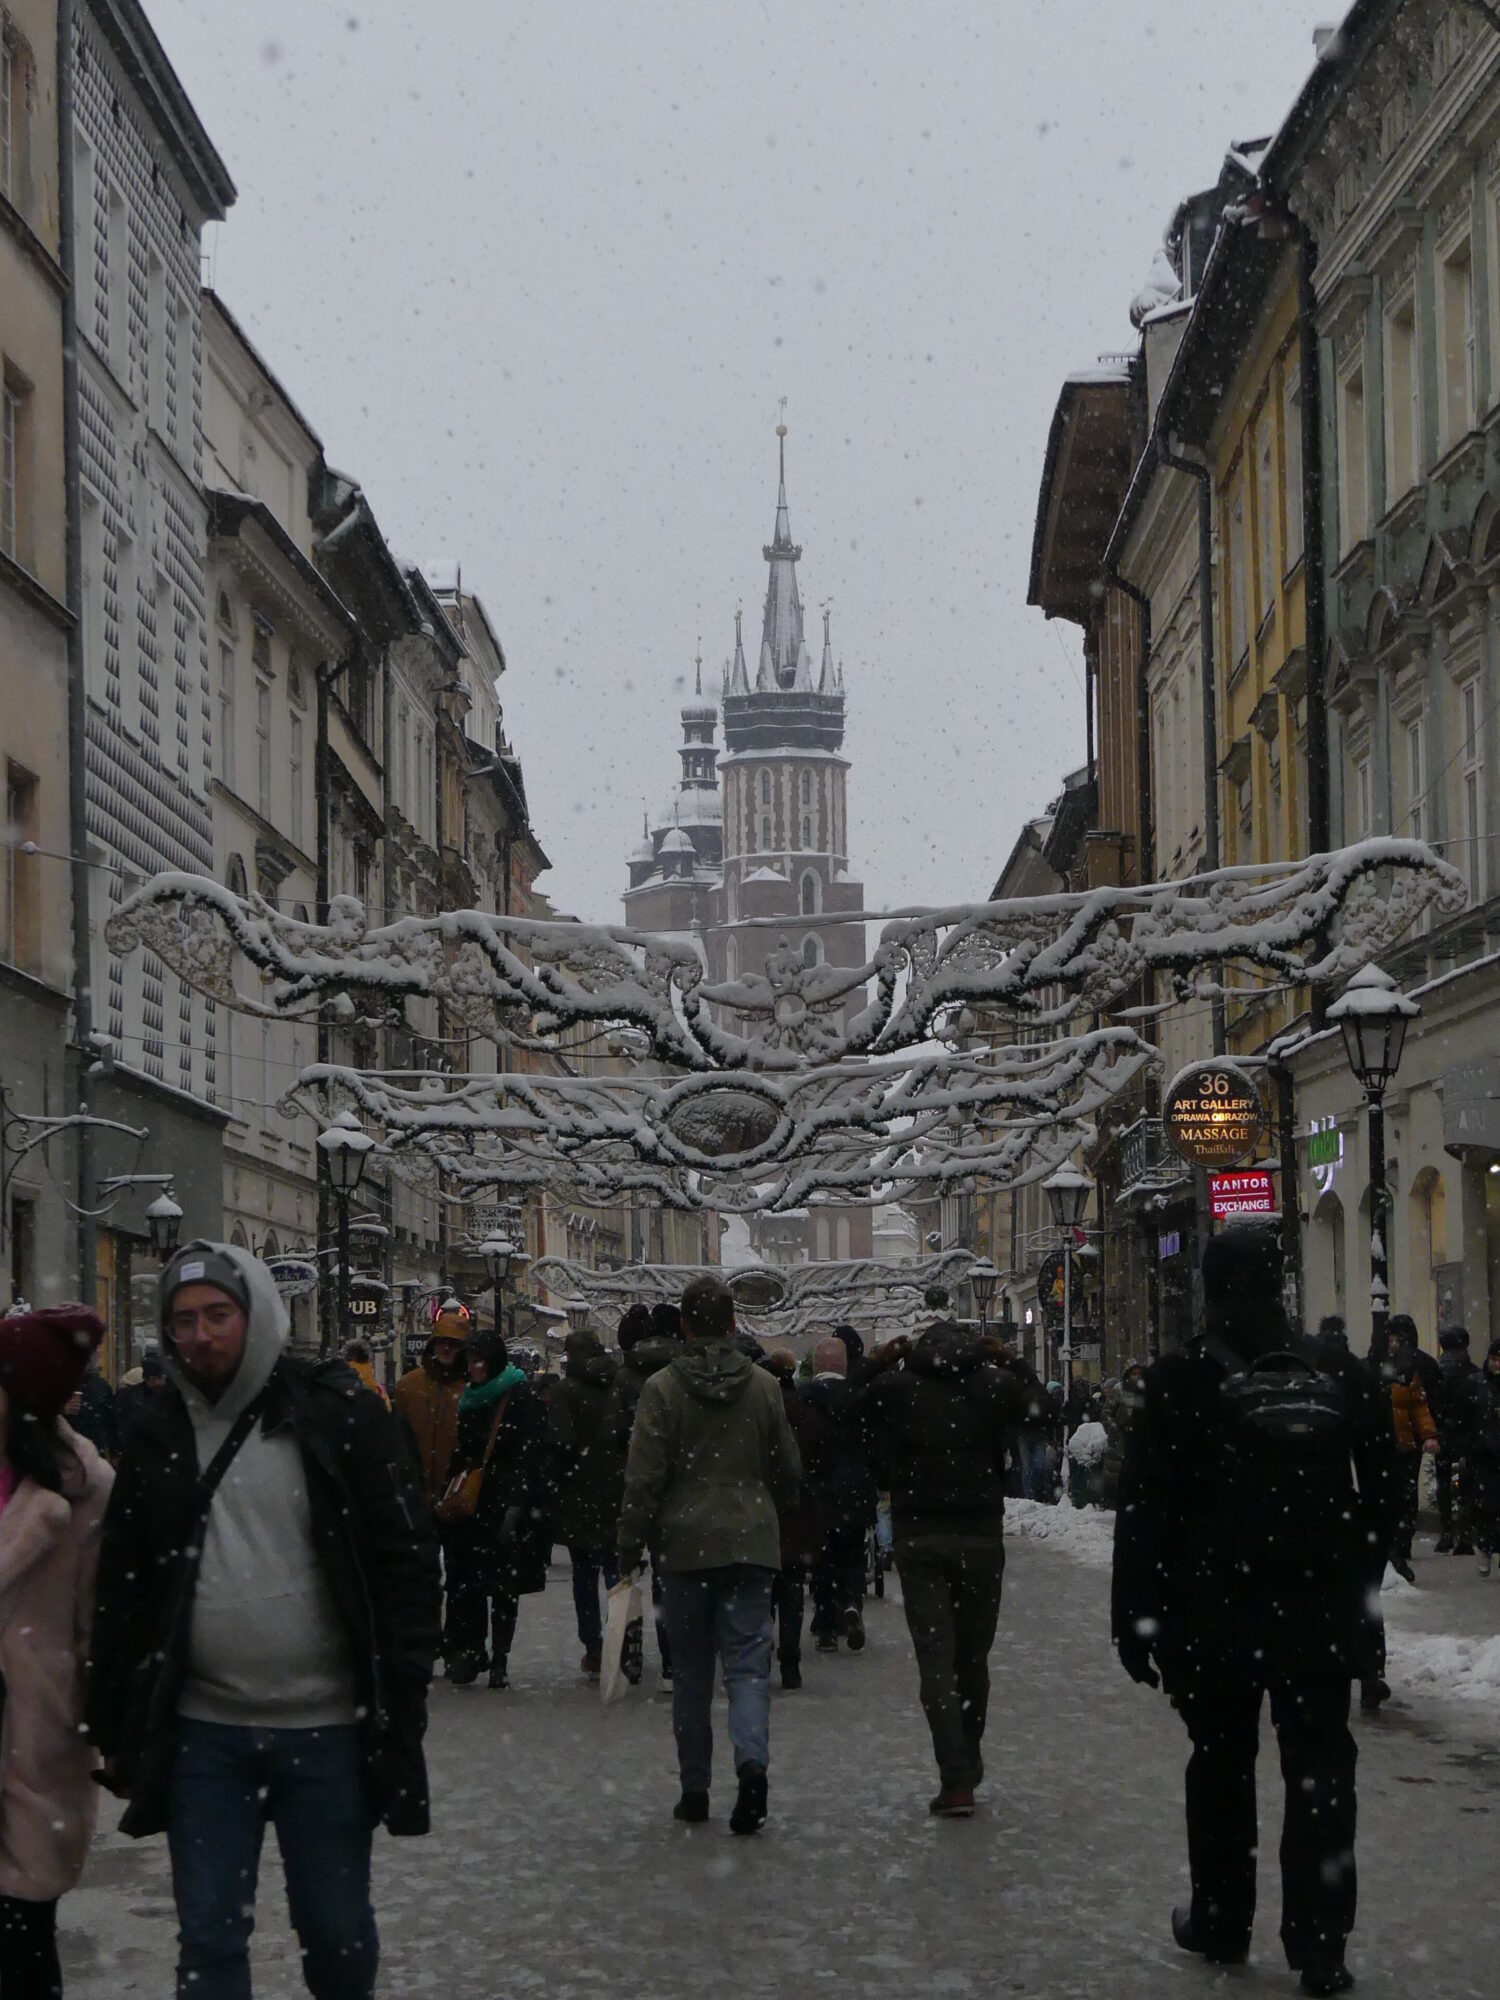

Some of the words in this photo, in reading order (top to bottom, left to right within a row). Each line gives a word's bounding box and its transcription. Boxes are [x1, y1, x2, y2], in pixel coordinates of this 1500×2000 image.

[1198, 1073, 1229, 1095] 36
[1174, 1100, 1197, 1109] ART
[1200, 1099, 1254, 1109] GALLERY
[1171, 1113, 1210, 1121] OPRAWA
[1180, 1128, 1248, 1140] MASSAGE
[1212, 1177, 1268, 1191] KANTOR
[1214, 1199, 1270, 1212] EXCHANGE
